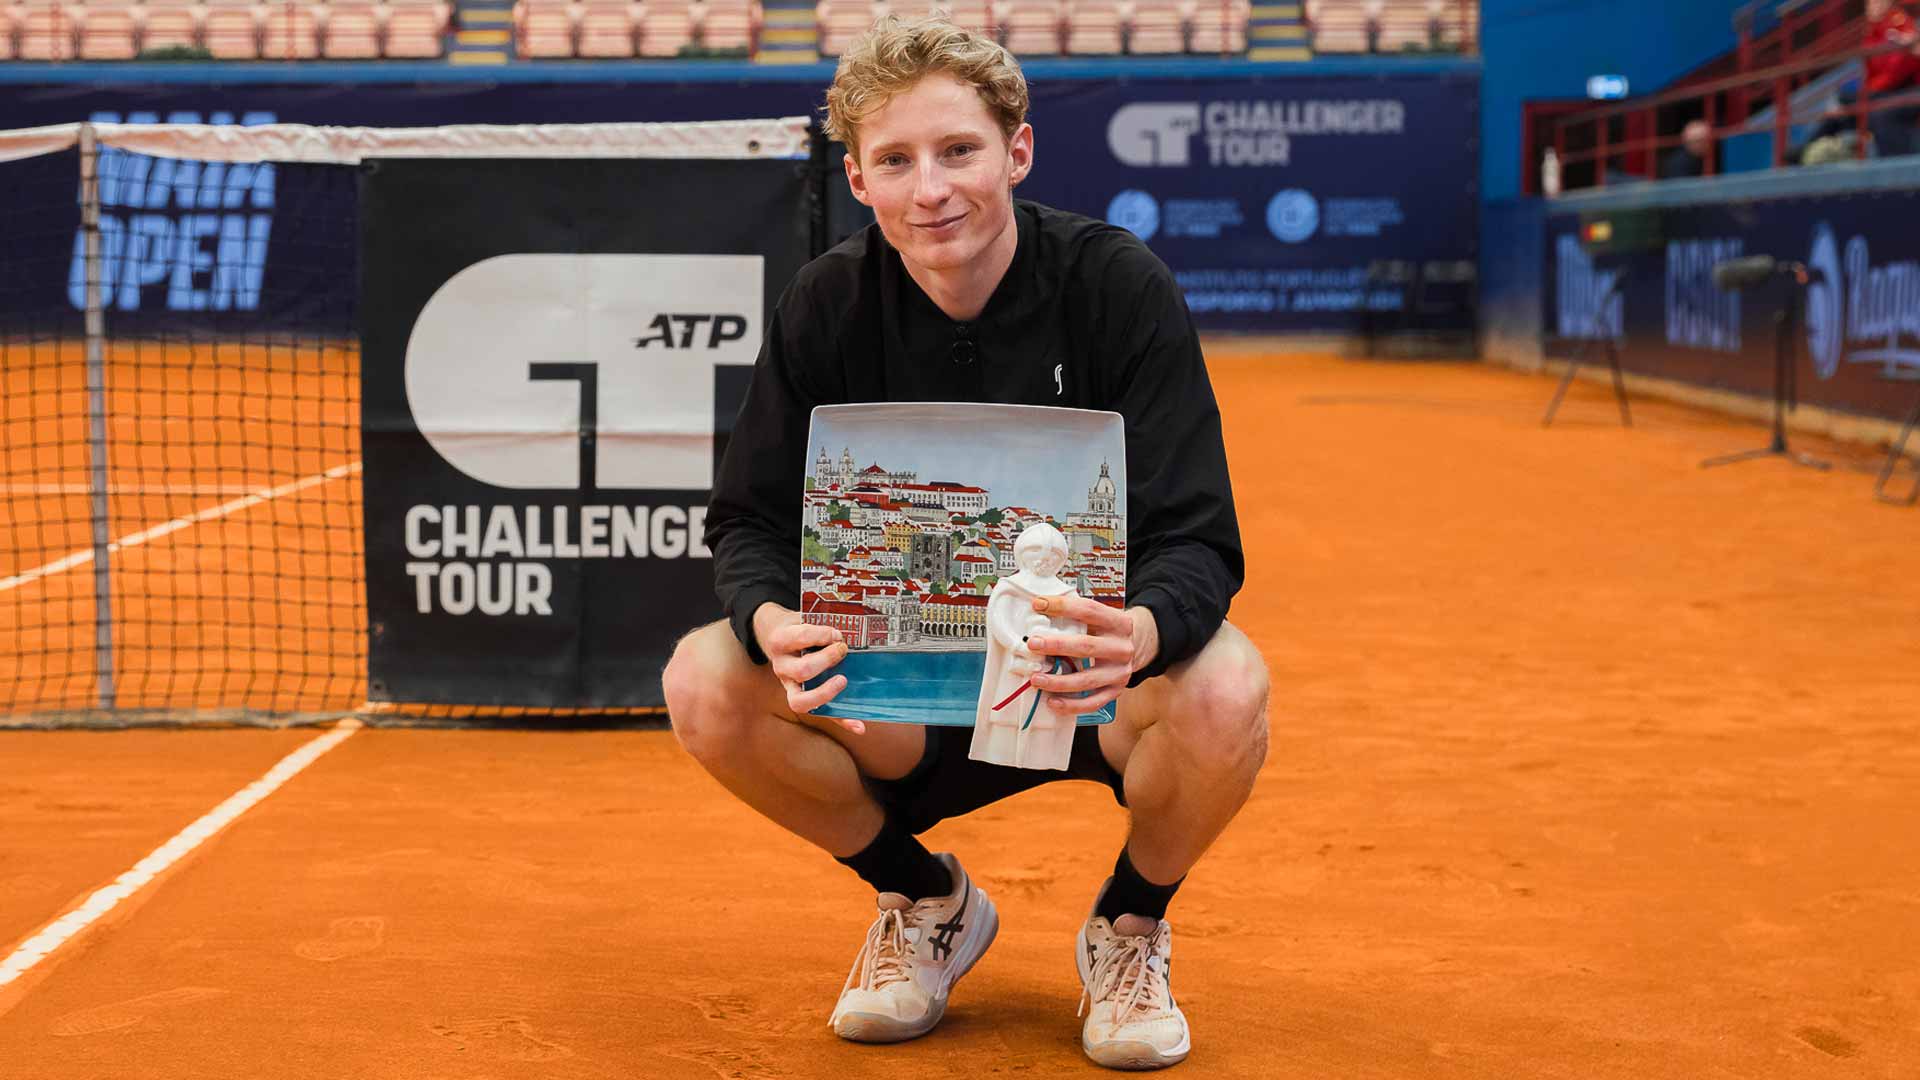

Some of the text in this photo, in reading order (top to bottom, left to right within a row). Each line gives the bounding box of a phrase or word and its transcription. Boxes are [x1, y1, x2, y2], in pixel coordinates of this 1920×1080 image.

[1204, 101, 1404, 135] CHALLENGER
[1206, 135, 1292, 167] TOUR
[67, 213, 273, 312] OPEN
[632, 313, 747, 349] ATP
[404, 504, 714, 559] CHALLENGE
[405, 561, 553, 616] TOUR
